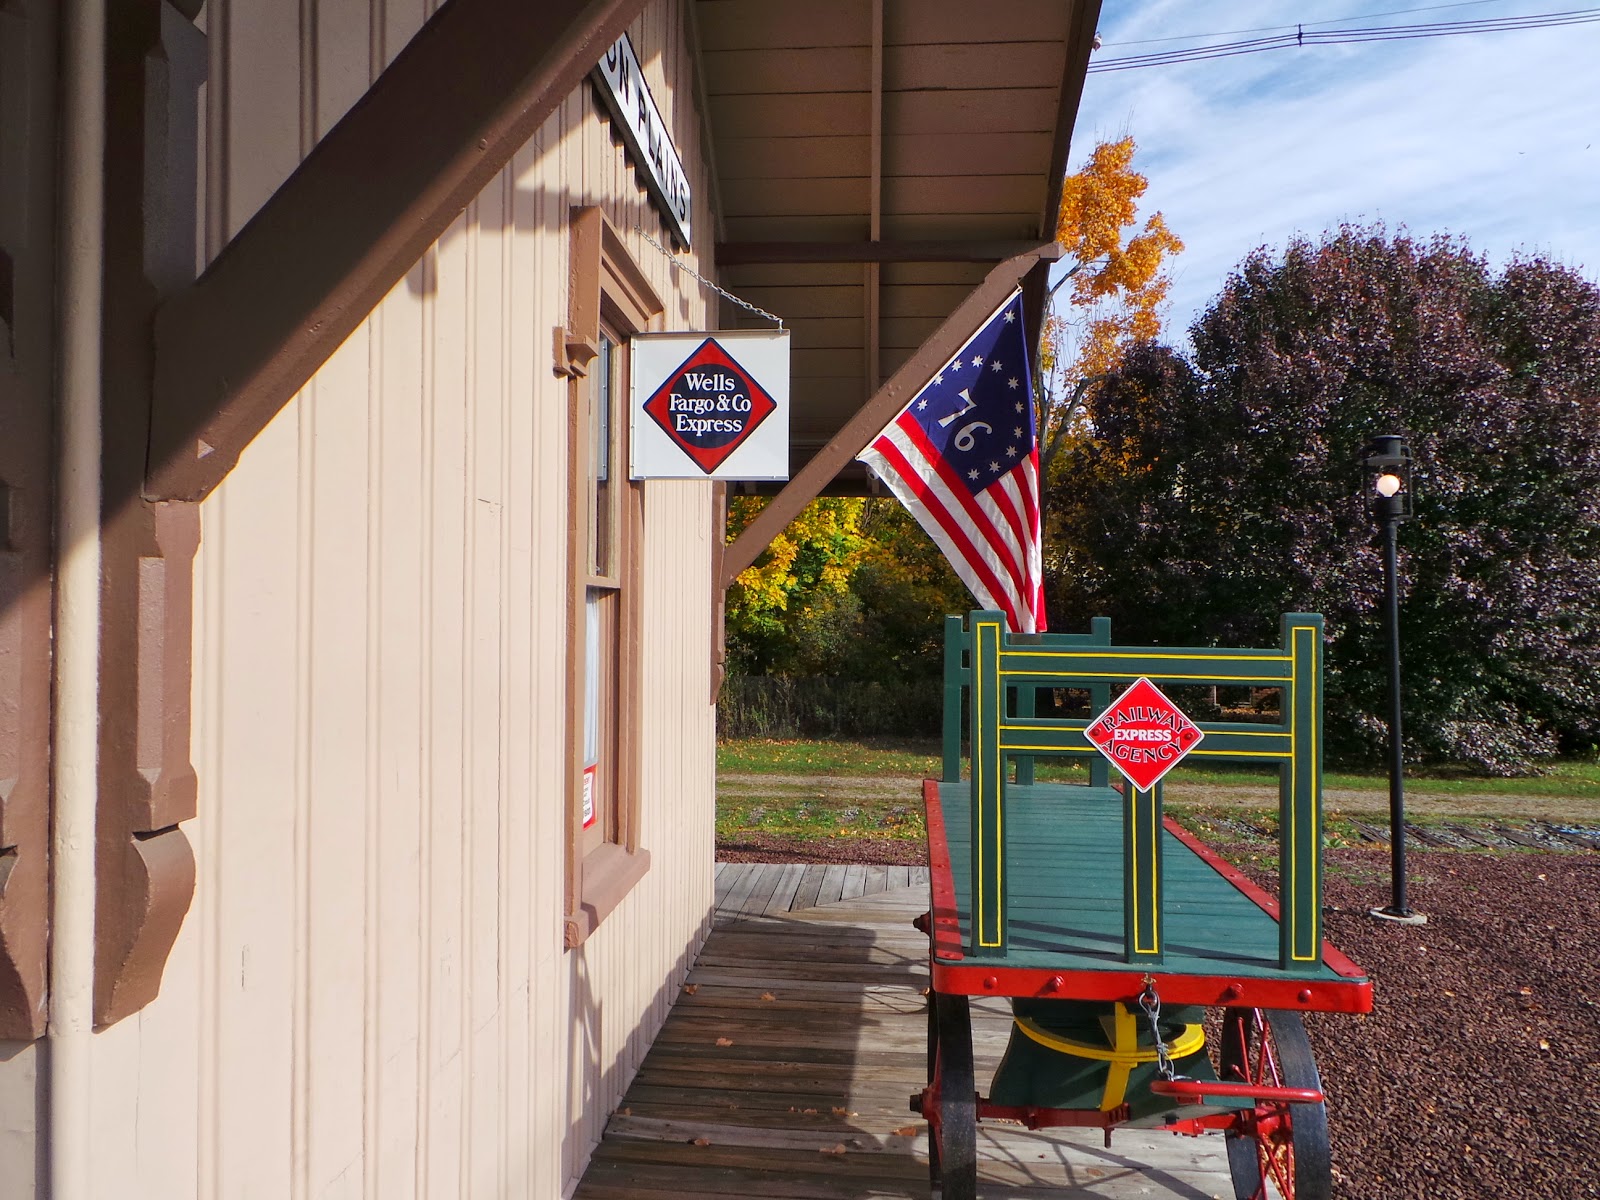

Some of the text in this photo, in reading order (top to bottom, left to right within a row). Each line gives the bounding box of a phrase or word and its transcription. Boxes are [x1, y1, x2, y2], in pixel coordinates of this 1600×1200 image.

[638, 86, 686, 222] PLAINS
[684, 373, 735, 391] Wells
[675, 413, 743, 437] Express
[937, 388, 993, 452] 76
[1100, 706, 1192, 734] RAILWAY
[1114, 728, 1172, 741] EXPRESS
[1099, 736, 1183, 763] AGENCY
